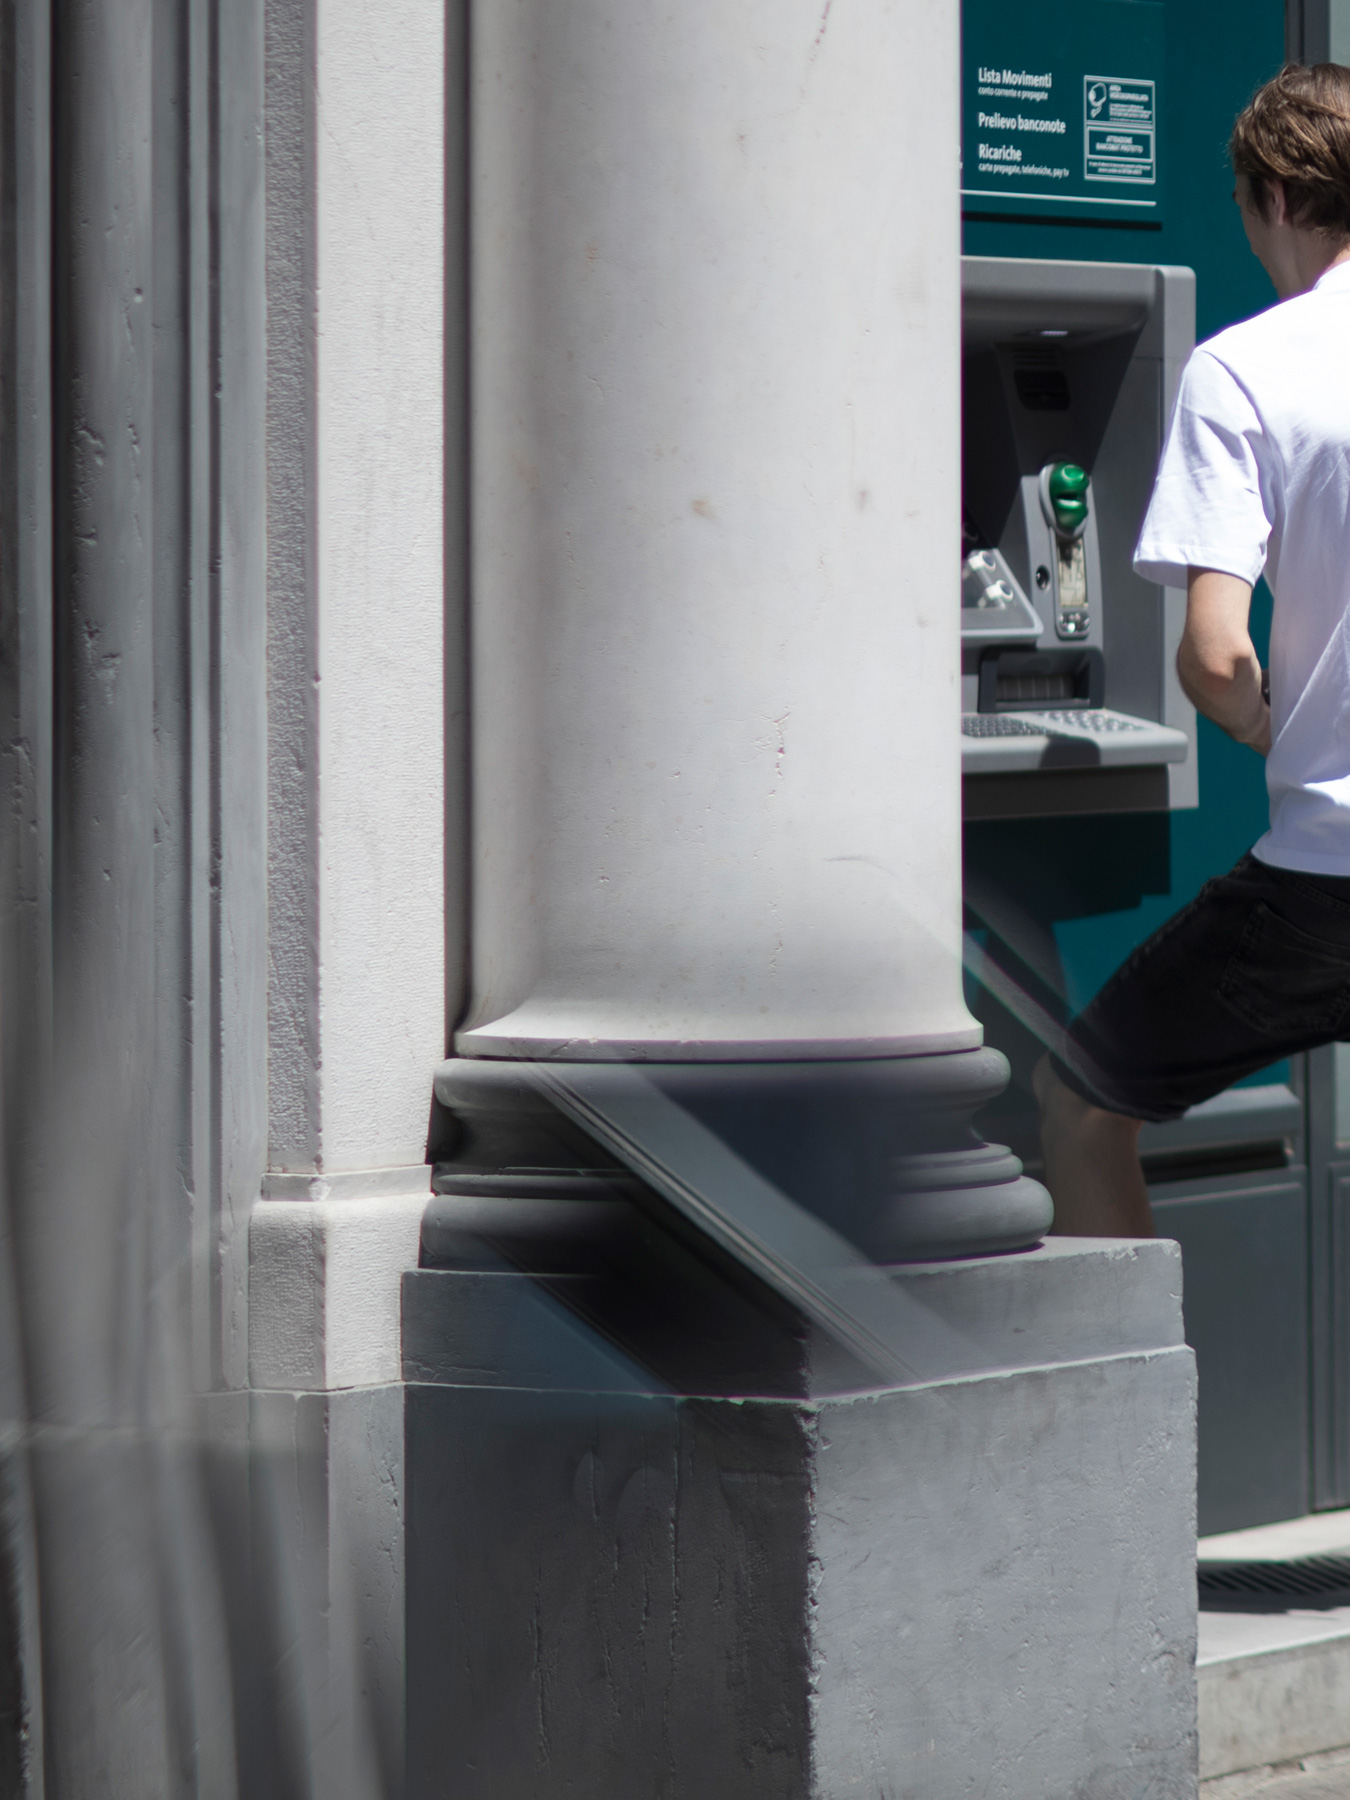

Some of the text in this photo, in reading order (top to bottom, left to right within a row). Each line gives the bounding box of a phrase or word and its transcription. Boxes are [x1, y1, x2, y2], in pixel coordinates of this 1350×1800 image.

[979, 68, 1052, 88] Lista Movimenti
[978, 86, 994, 96] conto
[994, 88, 1017, 98] corrente
[1022, 91, 1048, 102] prepagate
[979, 112, 1066, 134] Prelievo banconote
[979, 143, 1022, 162] Ricariche
[978, 163, 993, 172] carte
[1053, 168, 1063, 179] pay
